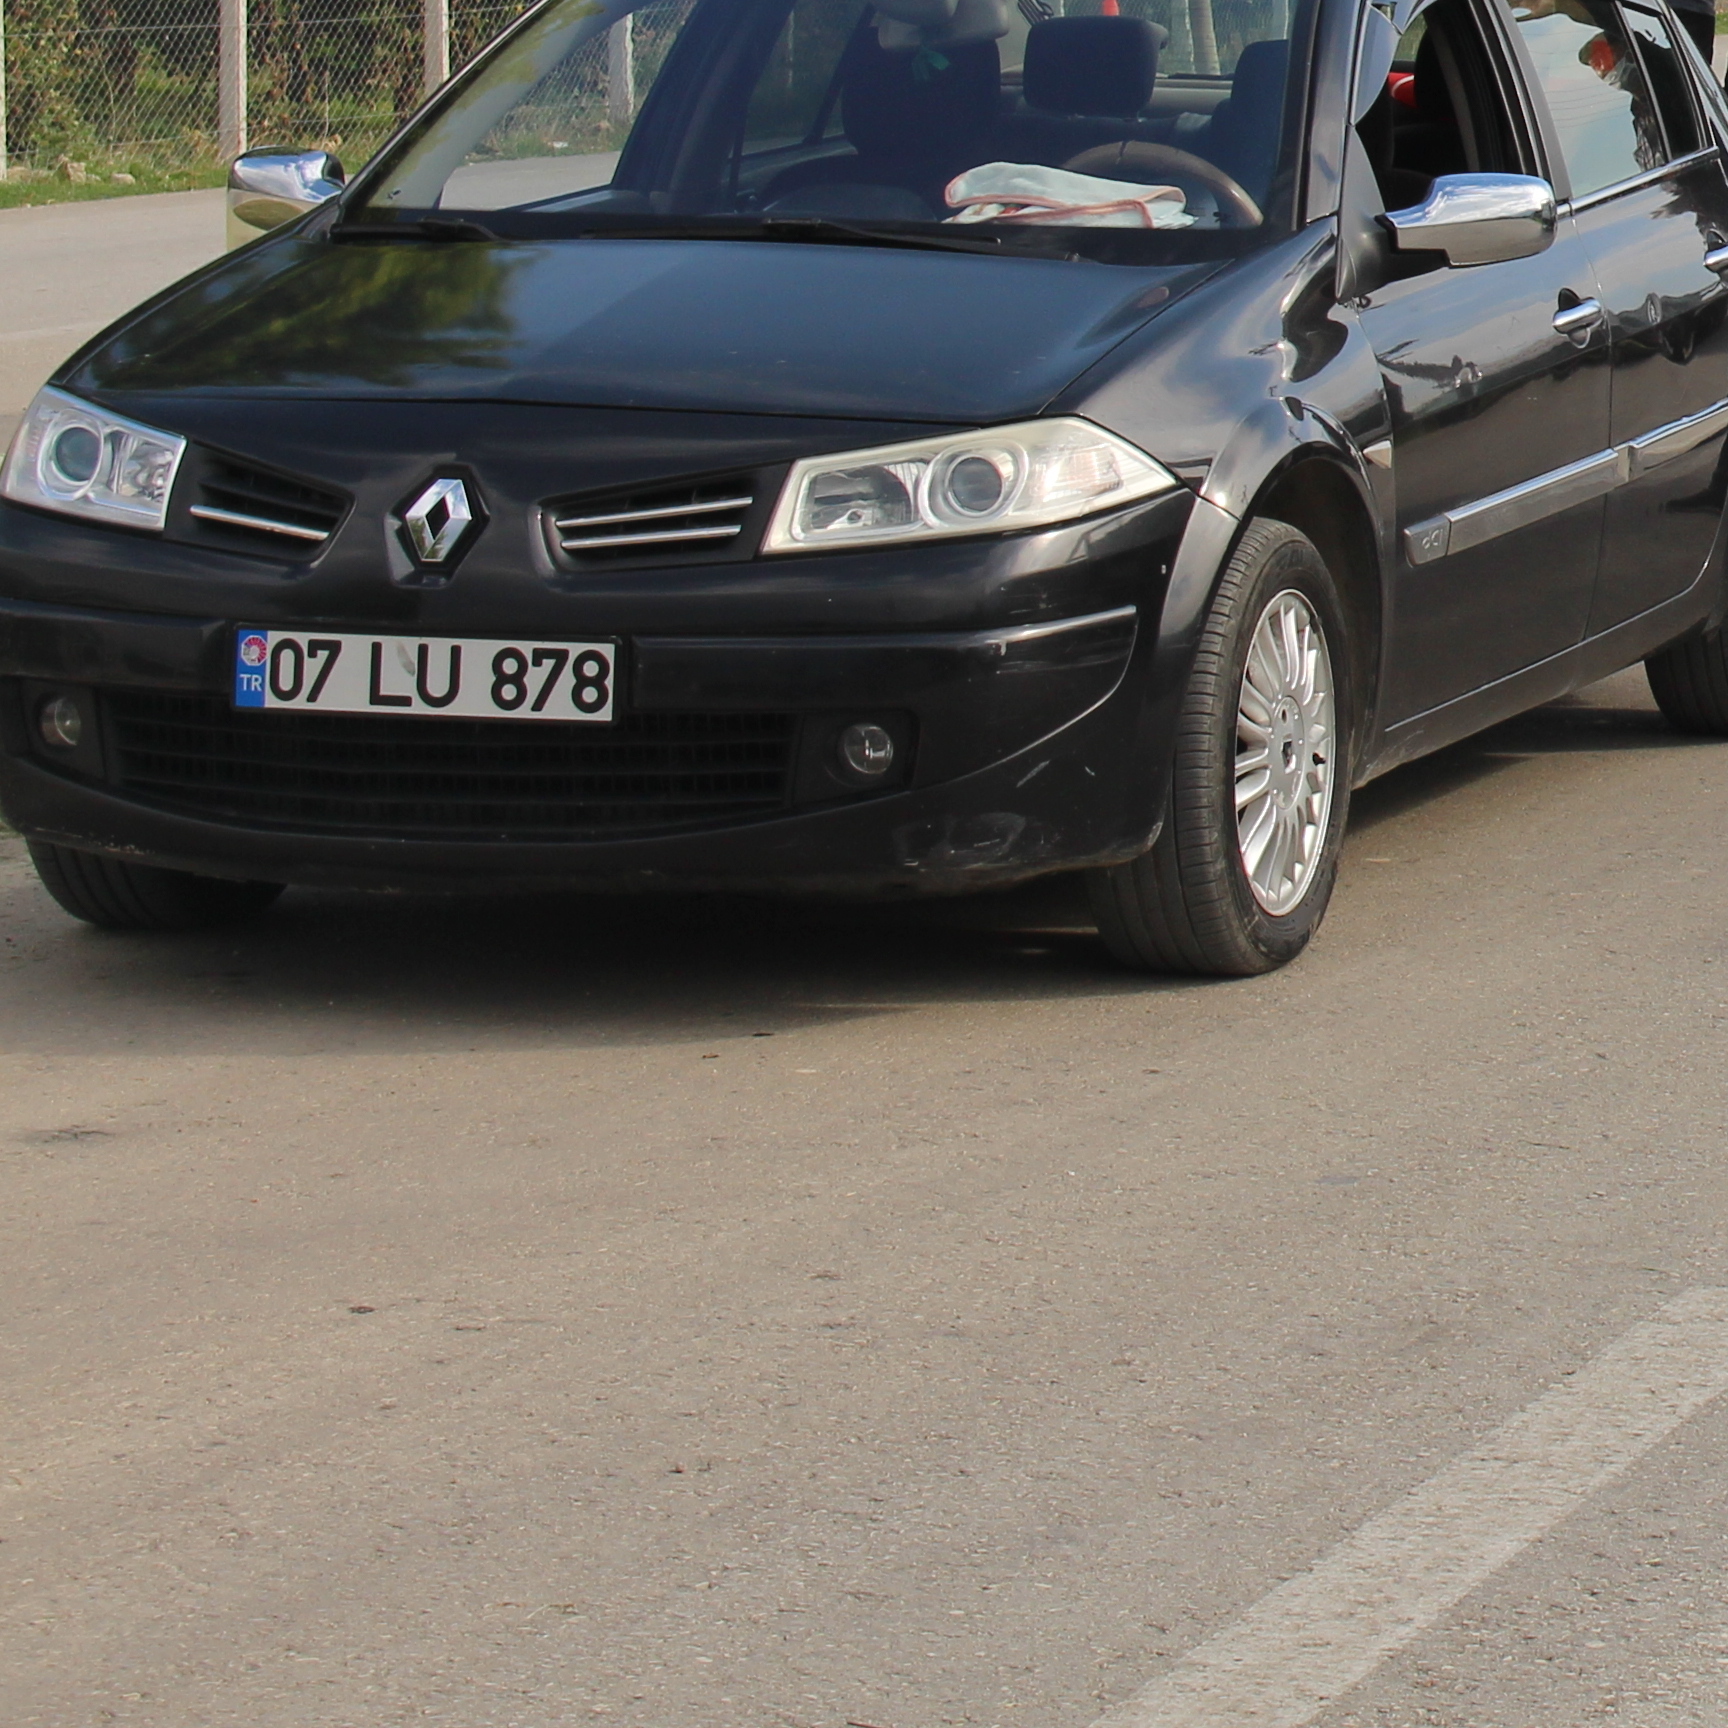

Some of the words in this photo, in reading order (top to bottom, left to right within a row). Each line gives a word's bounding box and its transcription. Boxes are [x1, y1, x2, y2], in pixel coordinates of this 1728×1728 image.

[240, 674, 262, 692] TR
[269, 638, 342, 703] 07
[370, 641, 461, 709] LU
[491, 646, 610, 714] 878
